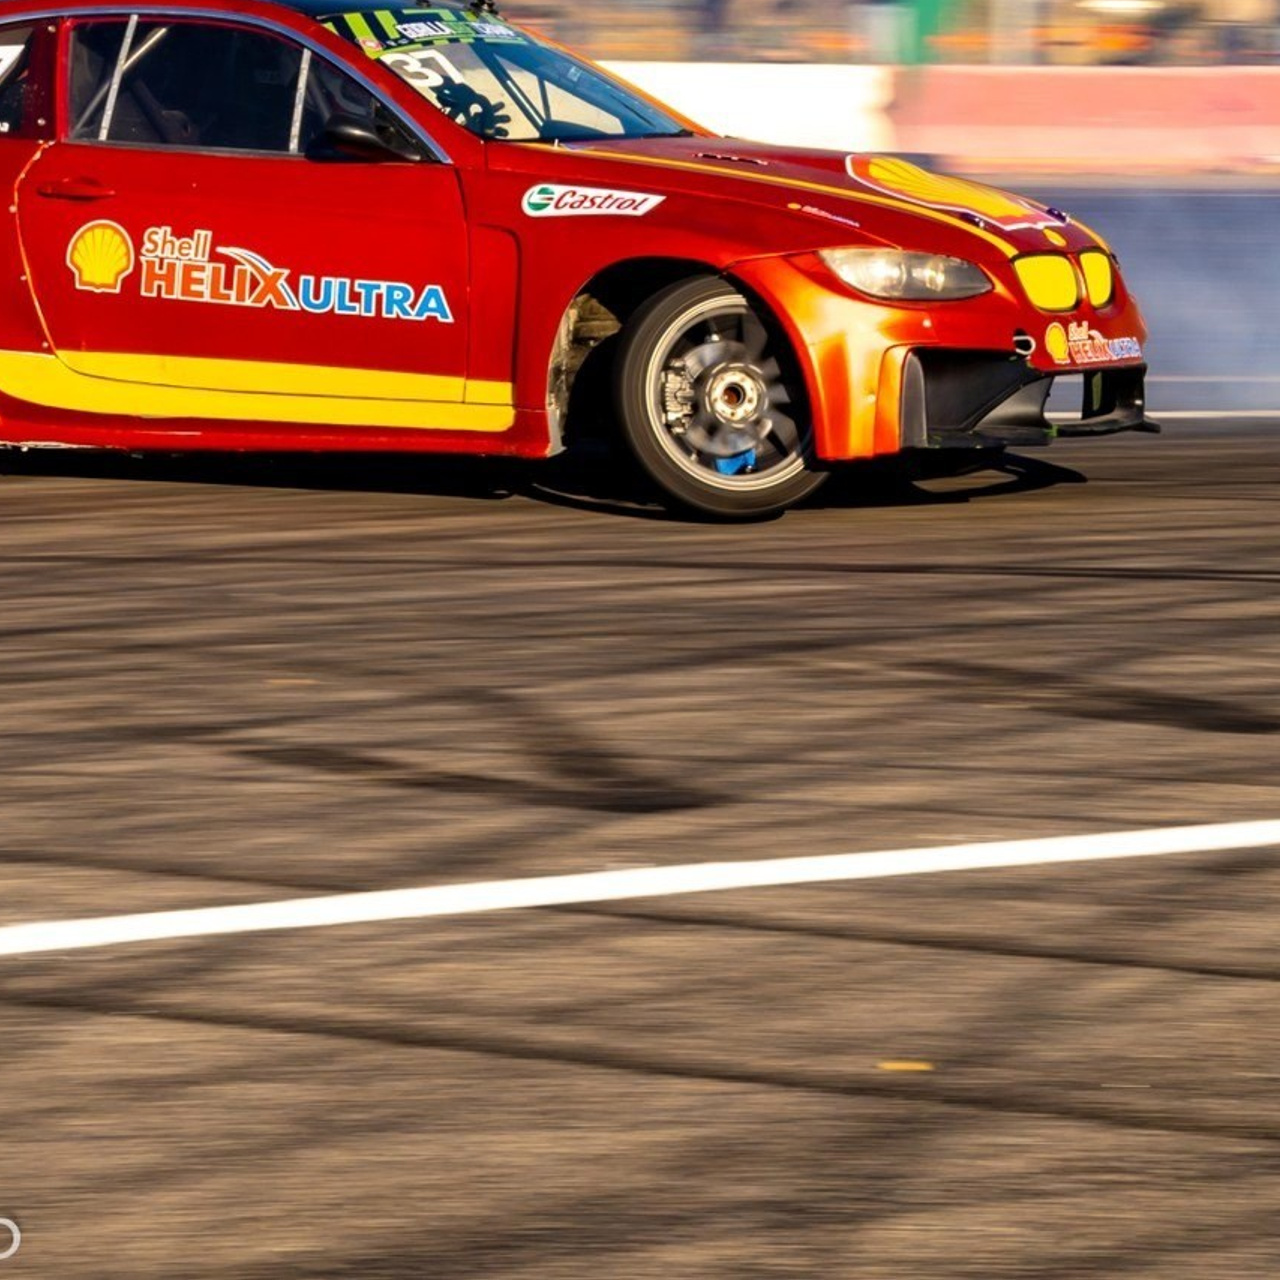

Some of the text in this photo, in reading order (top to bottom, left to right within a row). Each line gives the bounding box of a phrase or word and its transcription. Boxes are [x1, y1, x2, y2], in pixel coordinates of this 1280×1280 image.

[378, 49, 464, 87] 37
[554, 190, 650, 211] Castrol
[142, 227, 212, 260] Shell
[140, 255, 454, 322] HELIX ULTRA
